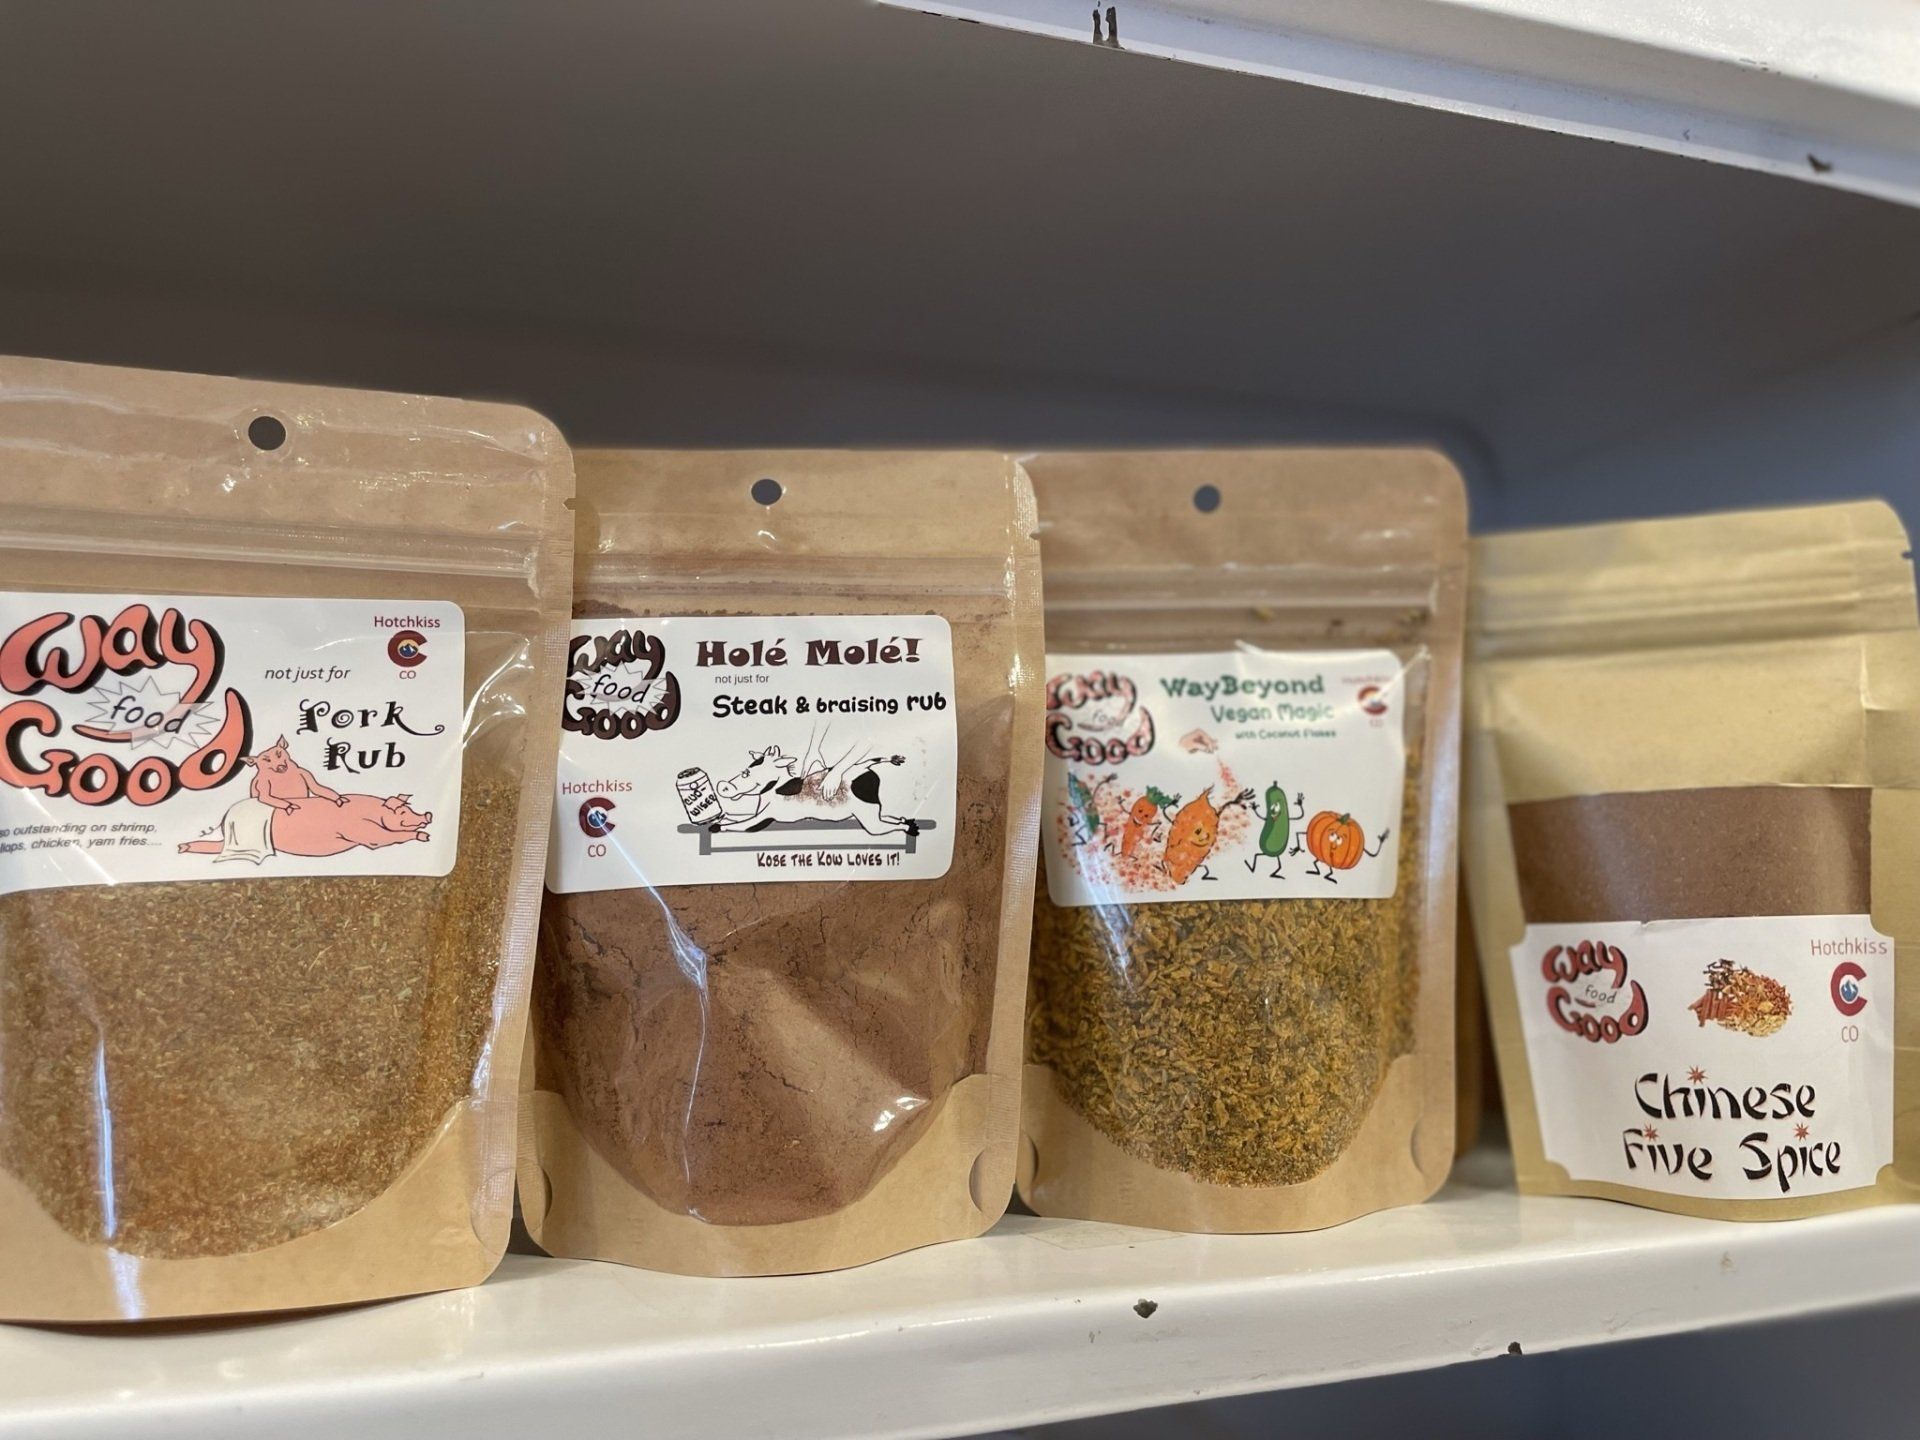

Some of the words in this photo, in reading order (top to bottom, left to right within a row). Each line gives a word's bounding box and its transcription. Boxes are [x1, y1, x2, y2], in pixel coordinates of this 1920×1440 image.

[374, 616, 441, 628] Hotchkiss
[696, 638, 788, 667] Holé
[805, 636, 924, 666] Molé!
[264, 669, 292, 680] not
[292, 667, 324, 683] just
[325, 666, 351, 682] for
[399, 670, 417, 680] CO
[715, 673, 732, 684] not
[734, 673, 753, 685] just
[755, 673, 770, 684] for
[591, 674, 650, 703] food
[1160, 674, 1325, 701] WayBeyond
[110, 695, 191, 733] food
[712, 694, 787, 718] Steak
[795, 696, 810, 713] &
[816, 696, 898, 715] braising
[906, 691, 947, 712] rub
[1211, 704, 1272, 723] Vegan
[1277, 703, 1336, 722] Magic
[296, 698, 446, 737] Pork
[0, 687, 254, 806] Good
[323, 736, 406, 774] Rub
[562, 780, 633, 795] Hotchkiss
[13, 822, 87, 837] outstanding
[90, 823, 107, 833] on
[111, 822, 158, 834] shrimp,
[31, 837, 82, 850] chicken,
[86, 836, 115, 849] yam
[587, 844, 607, 858] CO
[1810, 937, 1888, 956] Hotchkiss
[1584, 983, 1618, 1005] food
[1546, 979, 1650, 1044] Good
[1841, 1024, 1859, 1043] CO
[1634, 1068, 1816, 1120] Chinese
[1622, 1126, 1714, 1181] Five
[1738, 1126, 1842, 1193] Spice
